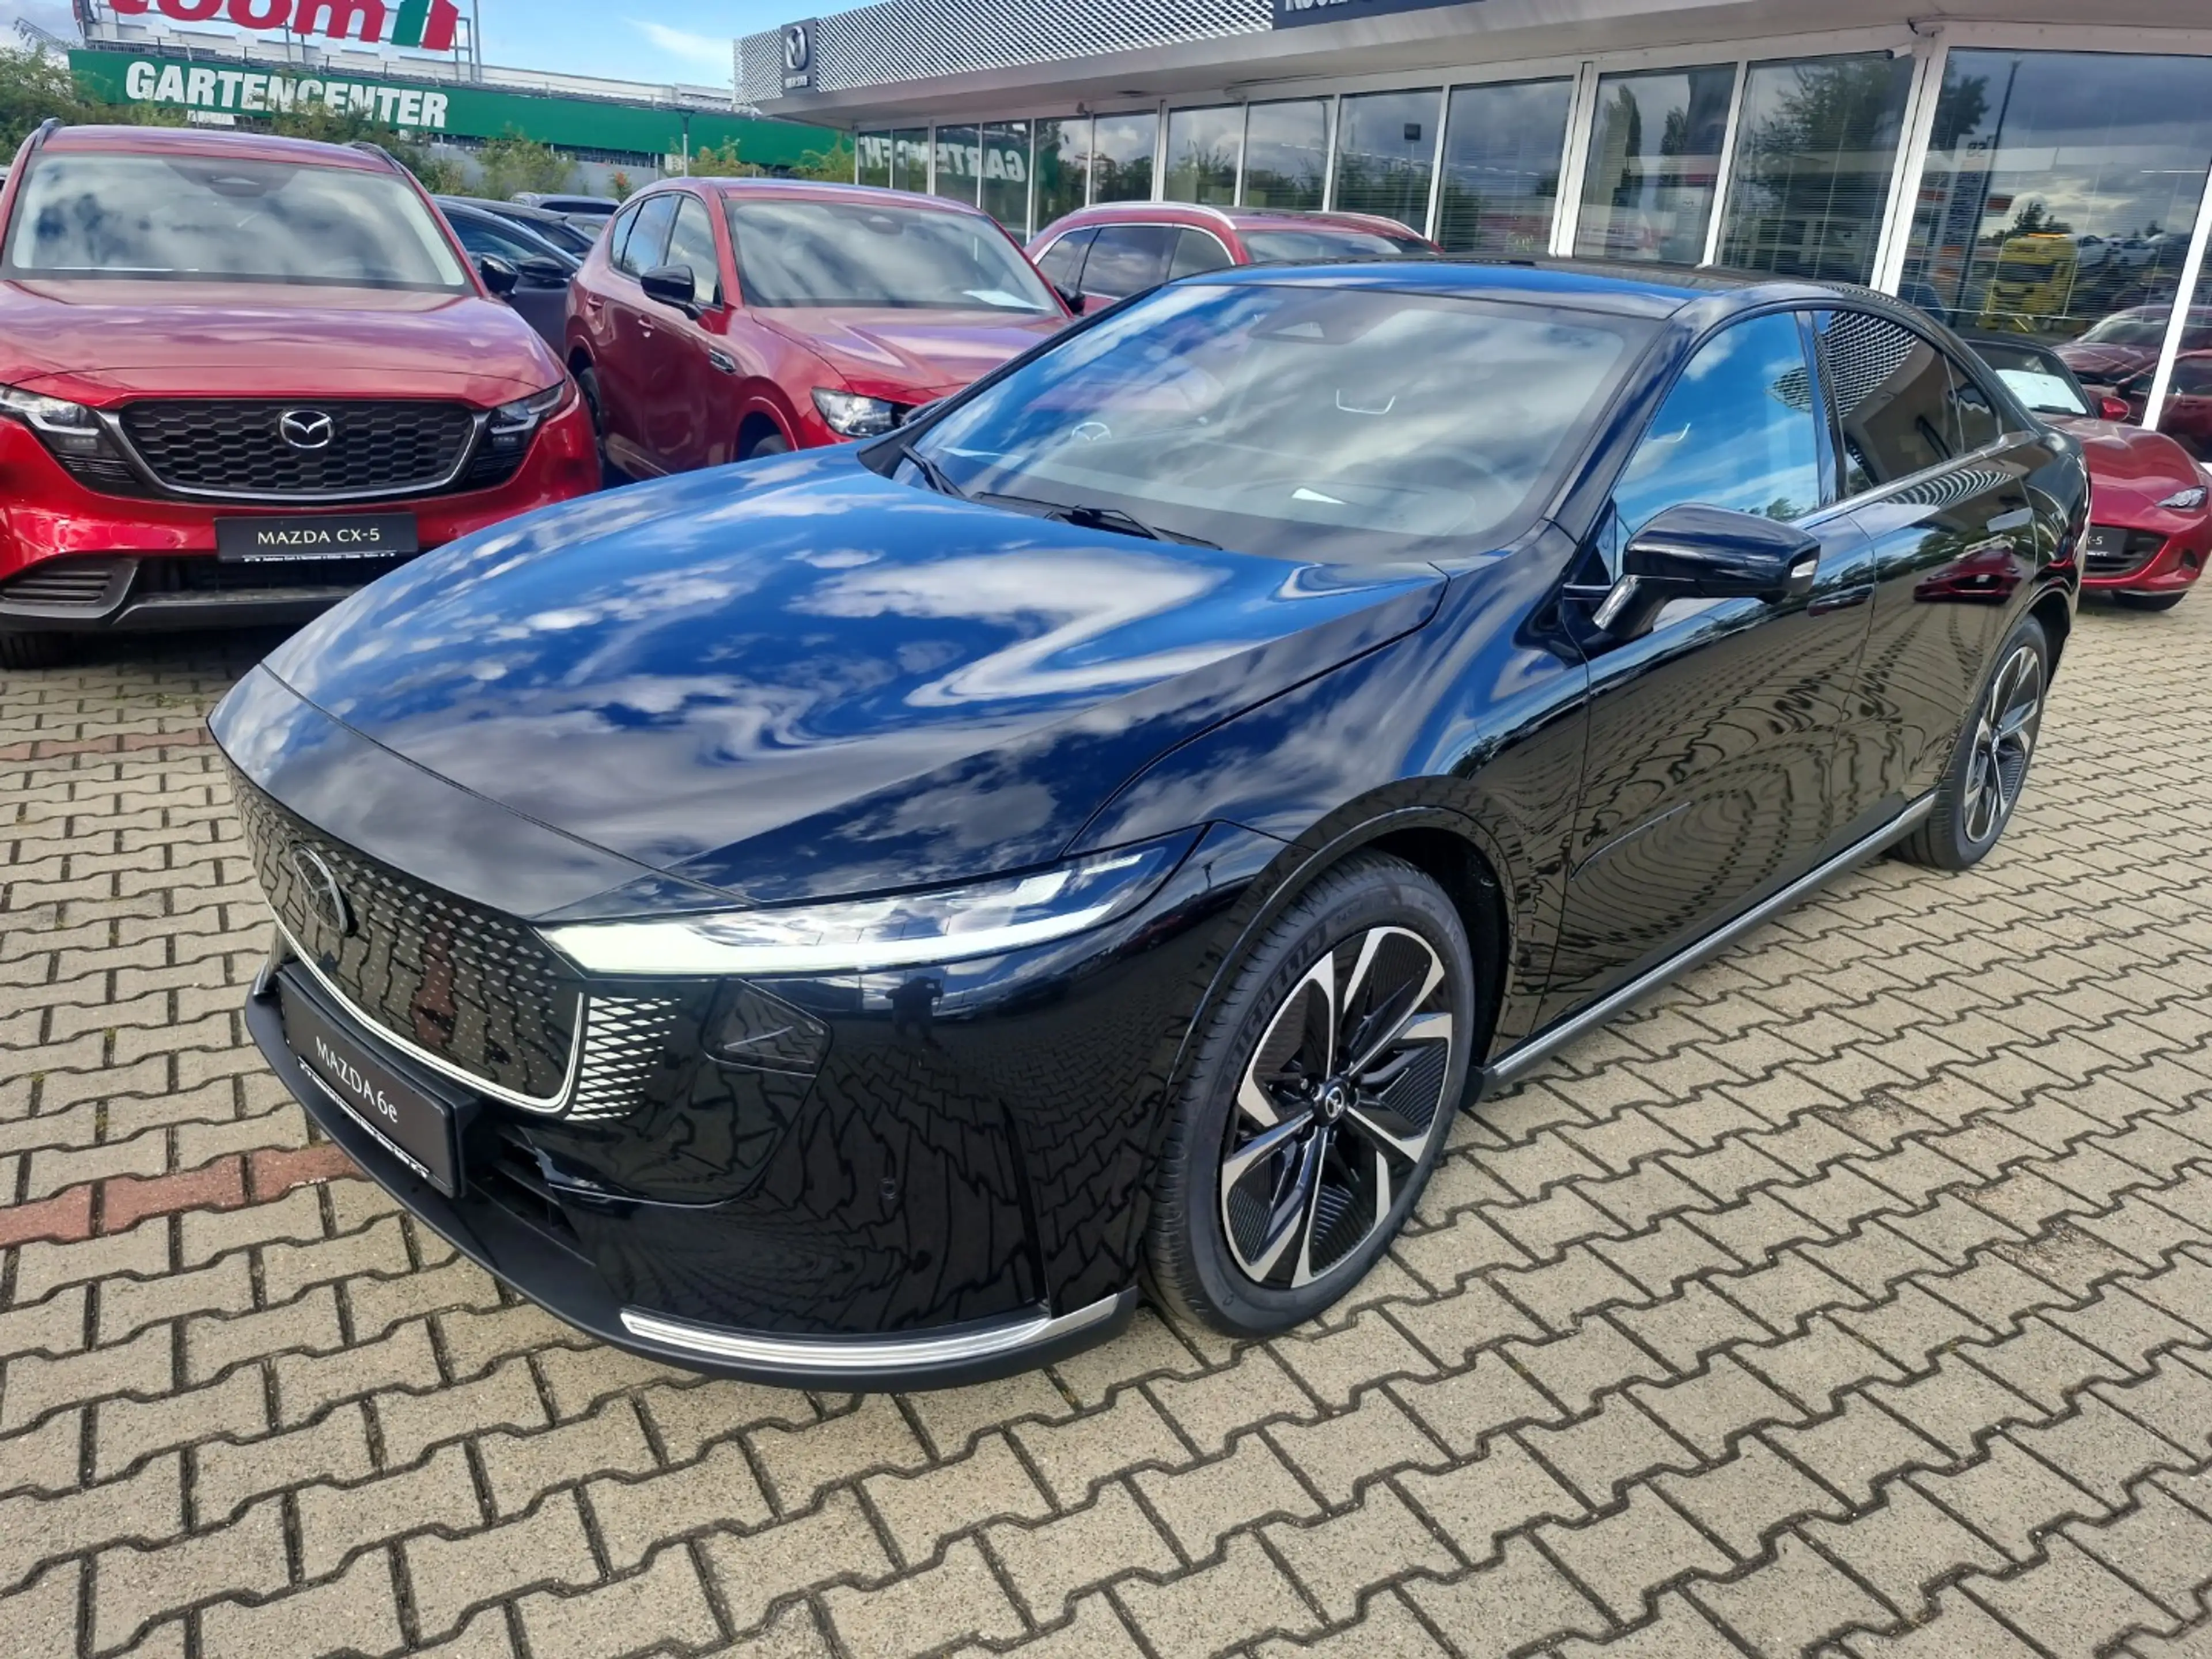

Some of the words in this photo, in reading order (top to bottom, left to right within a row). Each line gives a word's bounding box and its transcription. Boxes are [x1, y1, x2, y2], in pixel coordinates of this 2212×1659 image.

[126, 61, 449, 128] GARTENCENTER
[257, 531, 331, 544] MAZDA
[336, 528, 380, 542] CX-5
